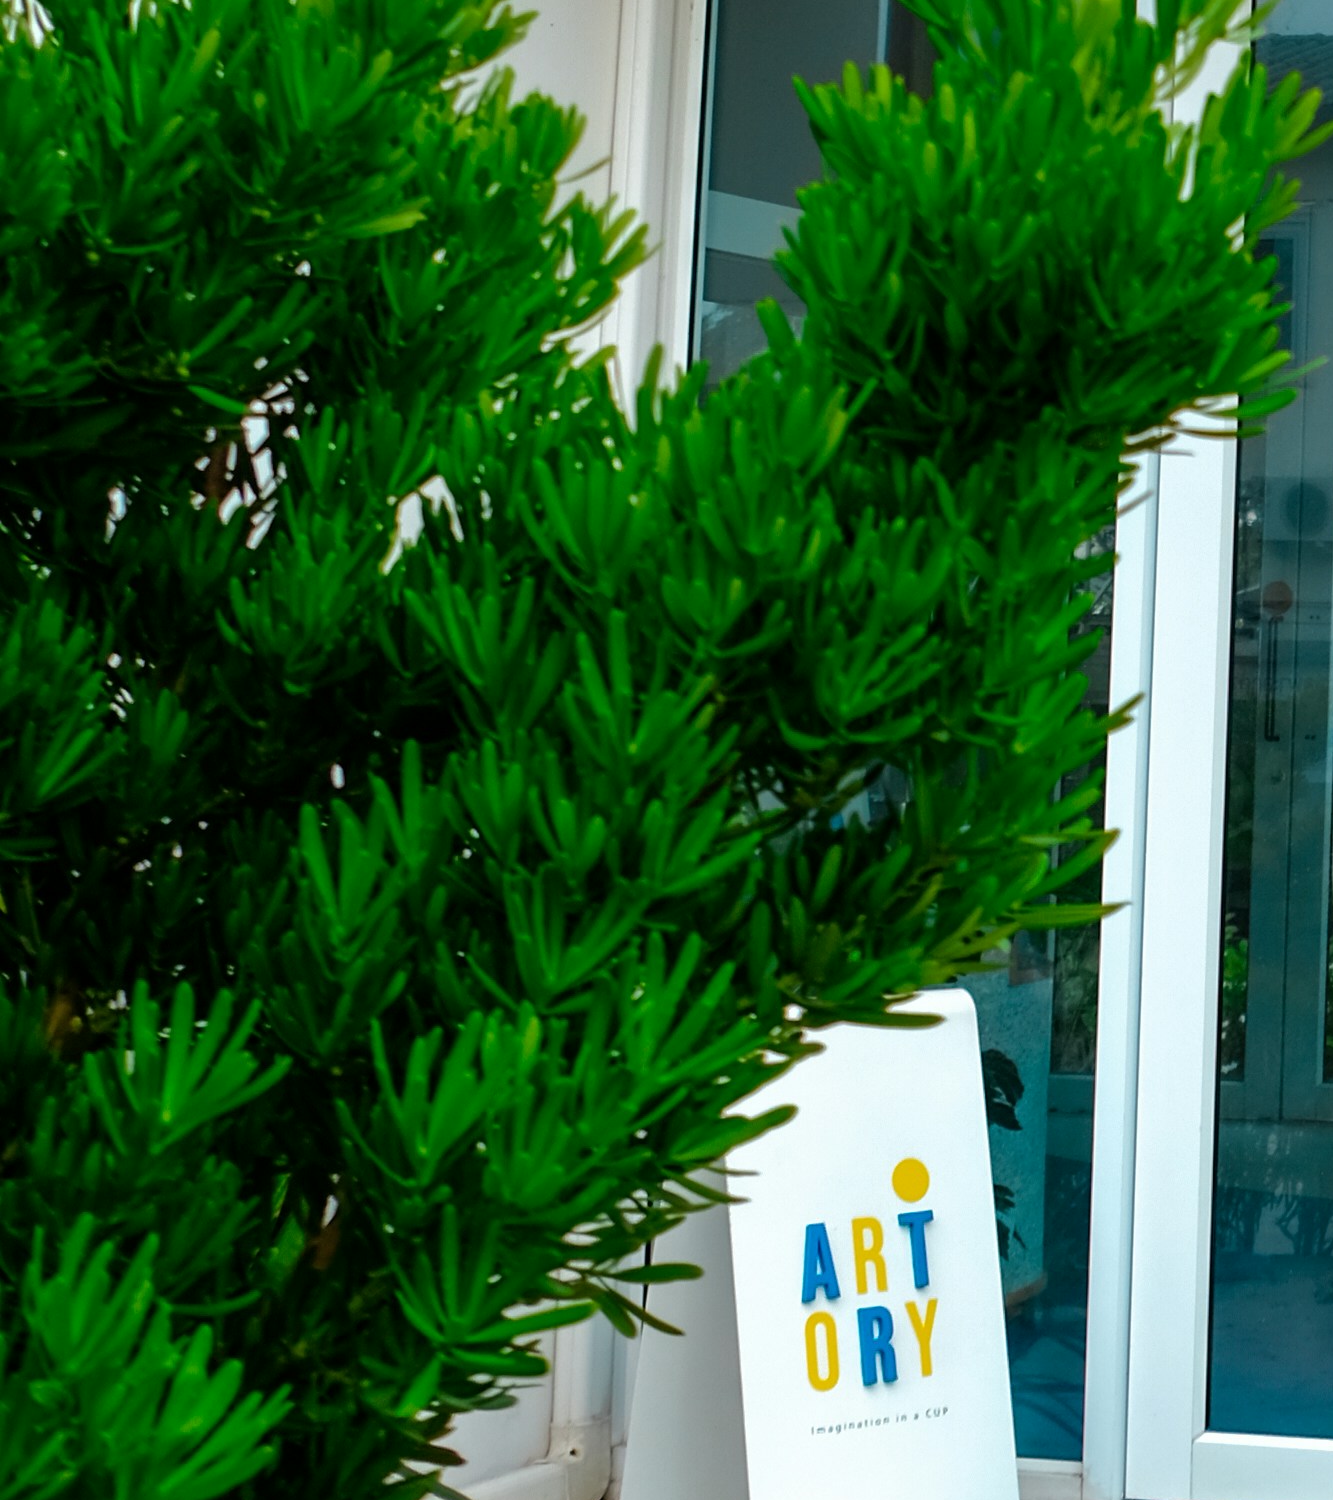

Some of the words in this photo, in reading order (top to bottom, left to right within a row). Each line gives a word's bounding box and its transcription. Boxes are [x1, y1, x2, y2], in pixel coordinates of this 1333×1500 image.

[801, 1209, 935, 1305] ART
[804, 1298, 939, 1393] ORY
[810, 1415, 891, 1436] Imagination
[895, 1413, 907, 1423] in
[912, 1412, 919, 1420] a
[925, 1406, 949, 1419] CUP
